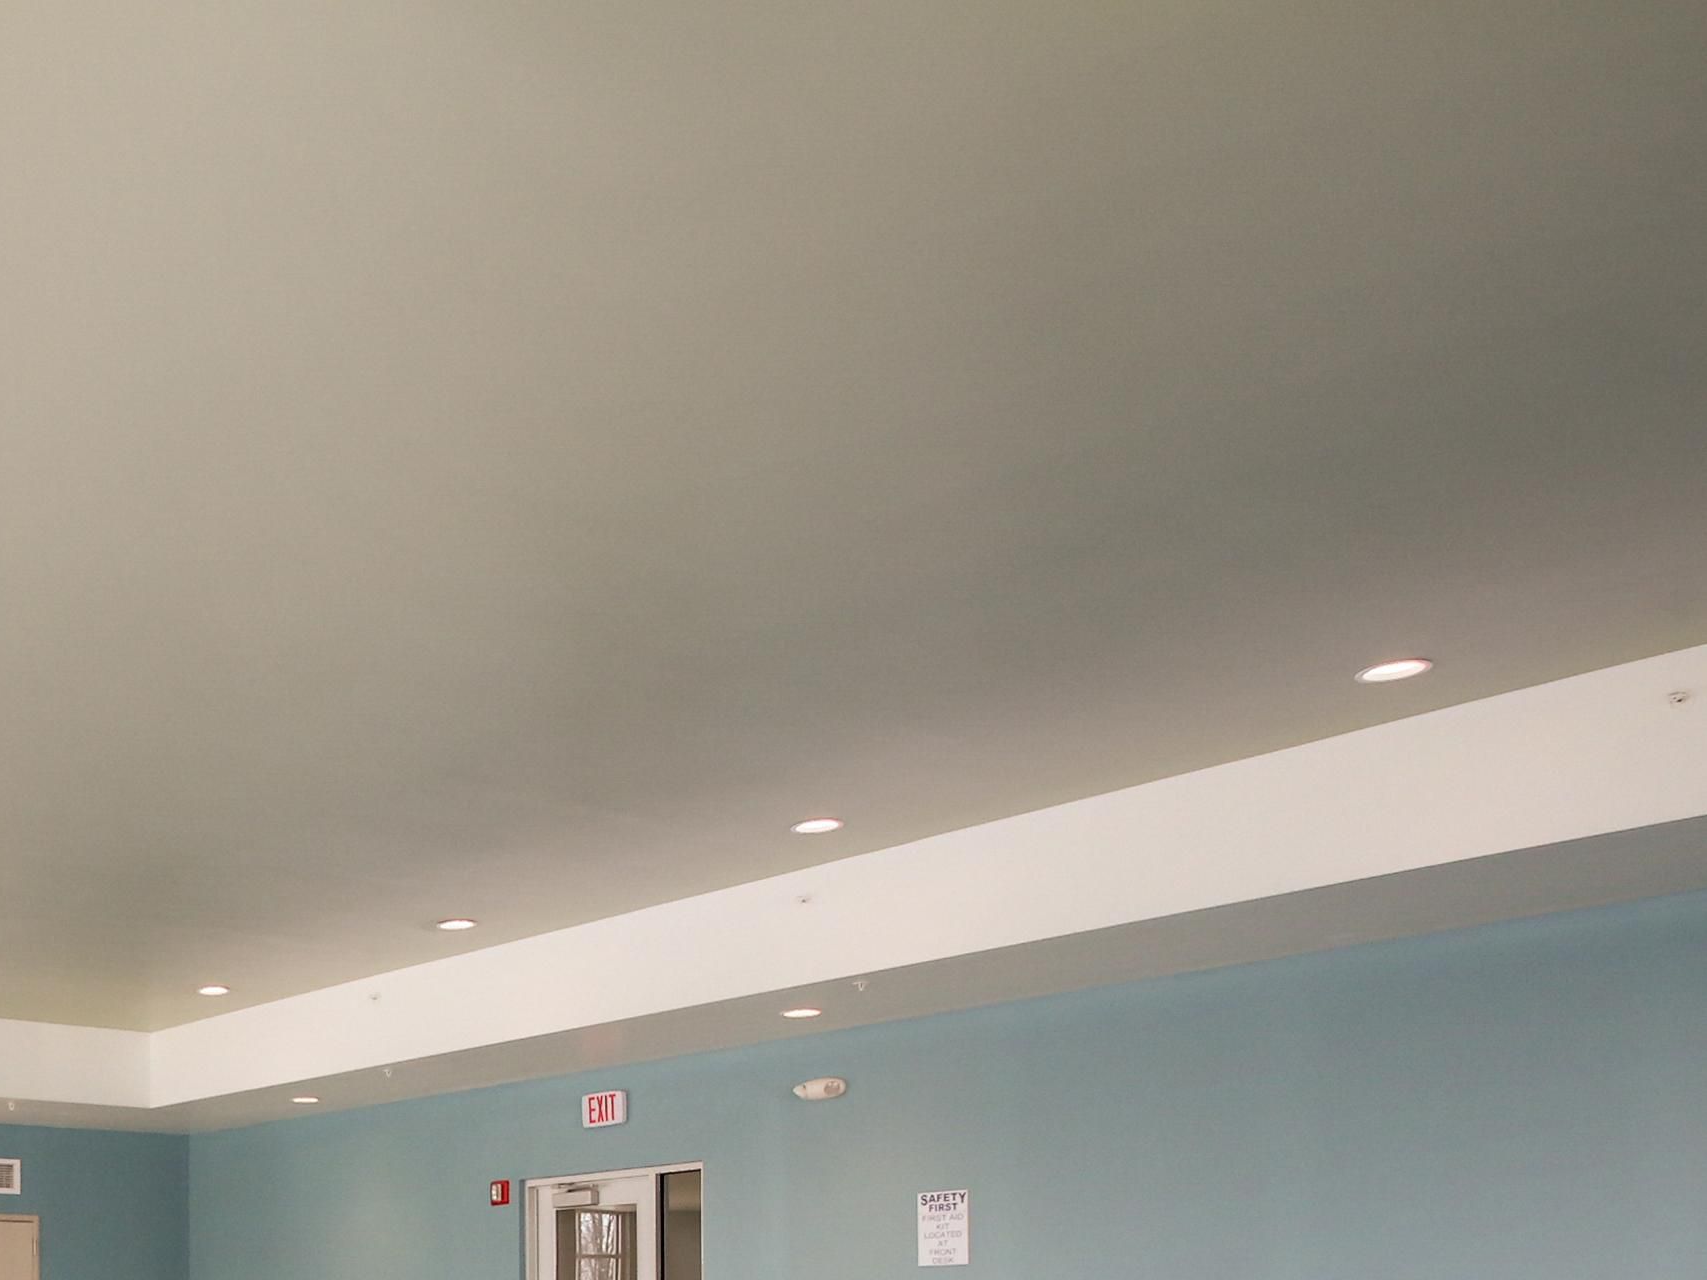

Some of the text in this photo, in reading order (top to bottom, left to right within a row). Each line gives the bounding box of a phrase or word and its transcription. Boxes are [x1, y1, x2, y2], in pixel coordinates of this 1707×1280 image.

[588, 1093, 616, 1124] EXIT
[920, 1192, 966, 1206] SAFETY
[929, 1203, 958, 1212] FIRST
[924, 1230, 962, 1239] LOCATED
